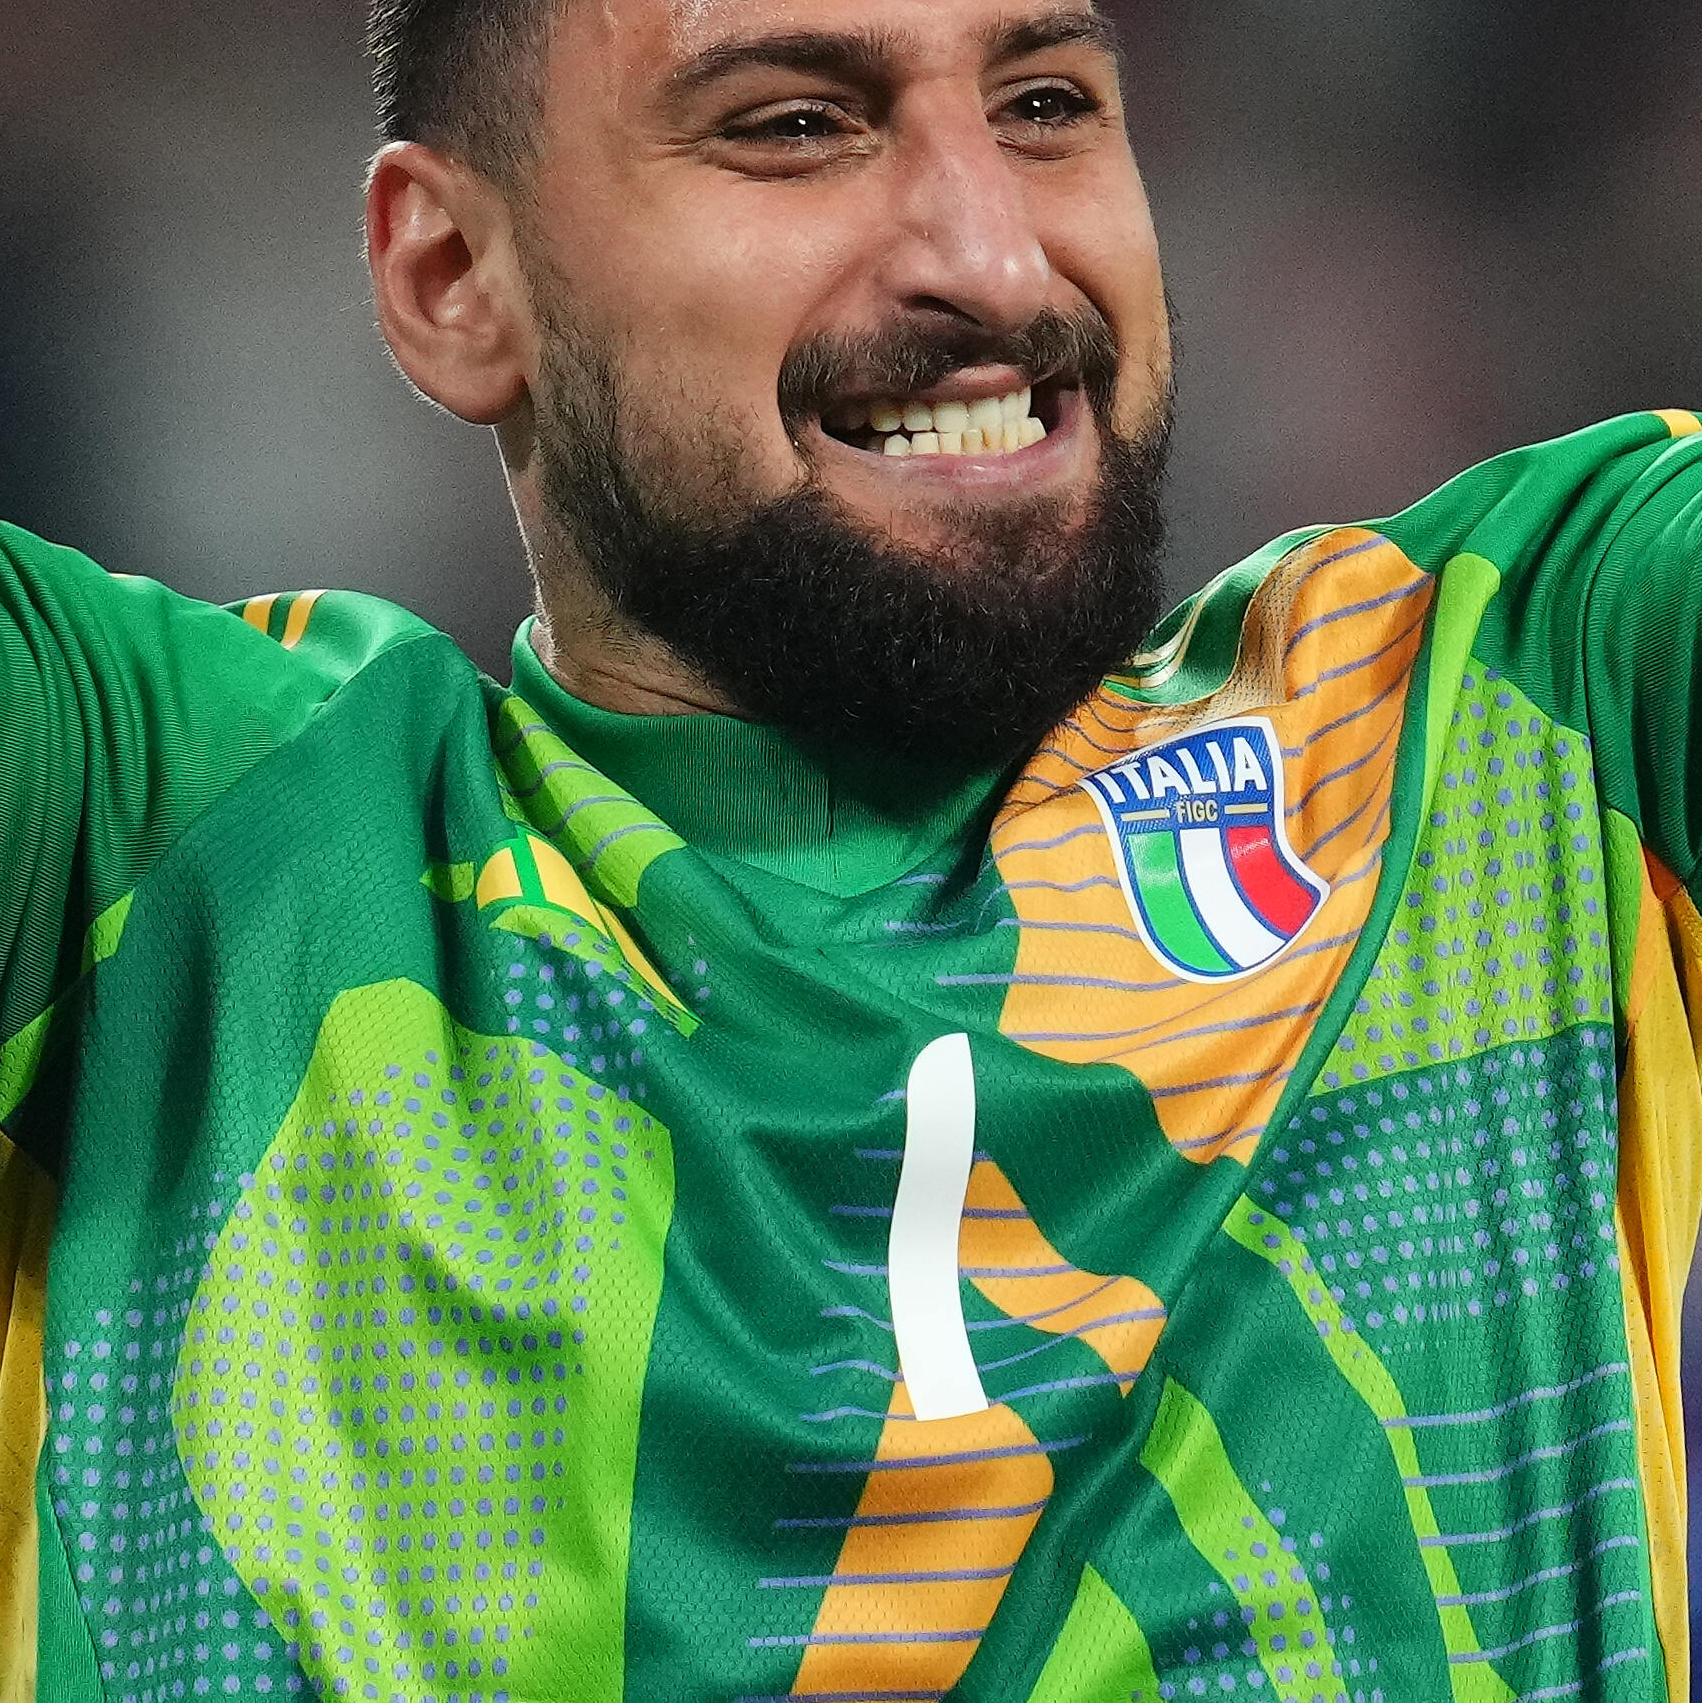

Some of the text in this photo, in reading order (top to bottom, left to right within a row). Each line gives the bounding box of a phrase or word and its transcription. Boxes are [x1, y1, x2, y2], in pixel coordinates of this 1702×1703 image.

[1094, 736, 1268, 803] ITALIA
[1175, 799, 1219, 824] FIGC
[888, 1032, 989, 1421] 1
